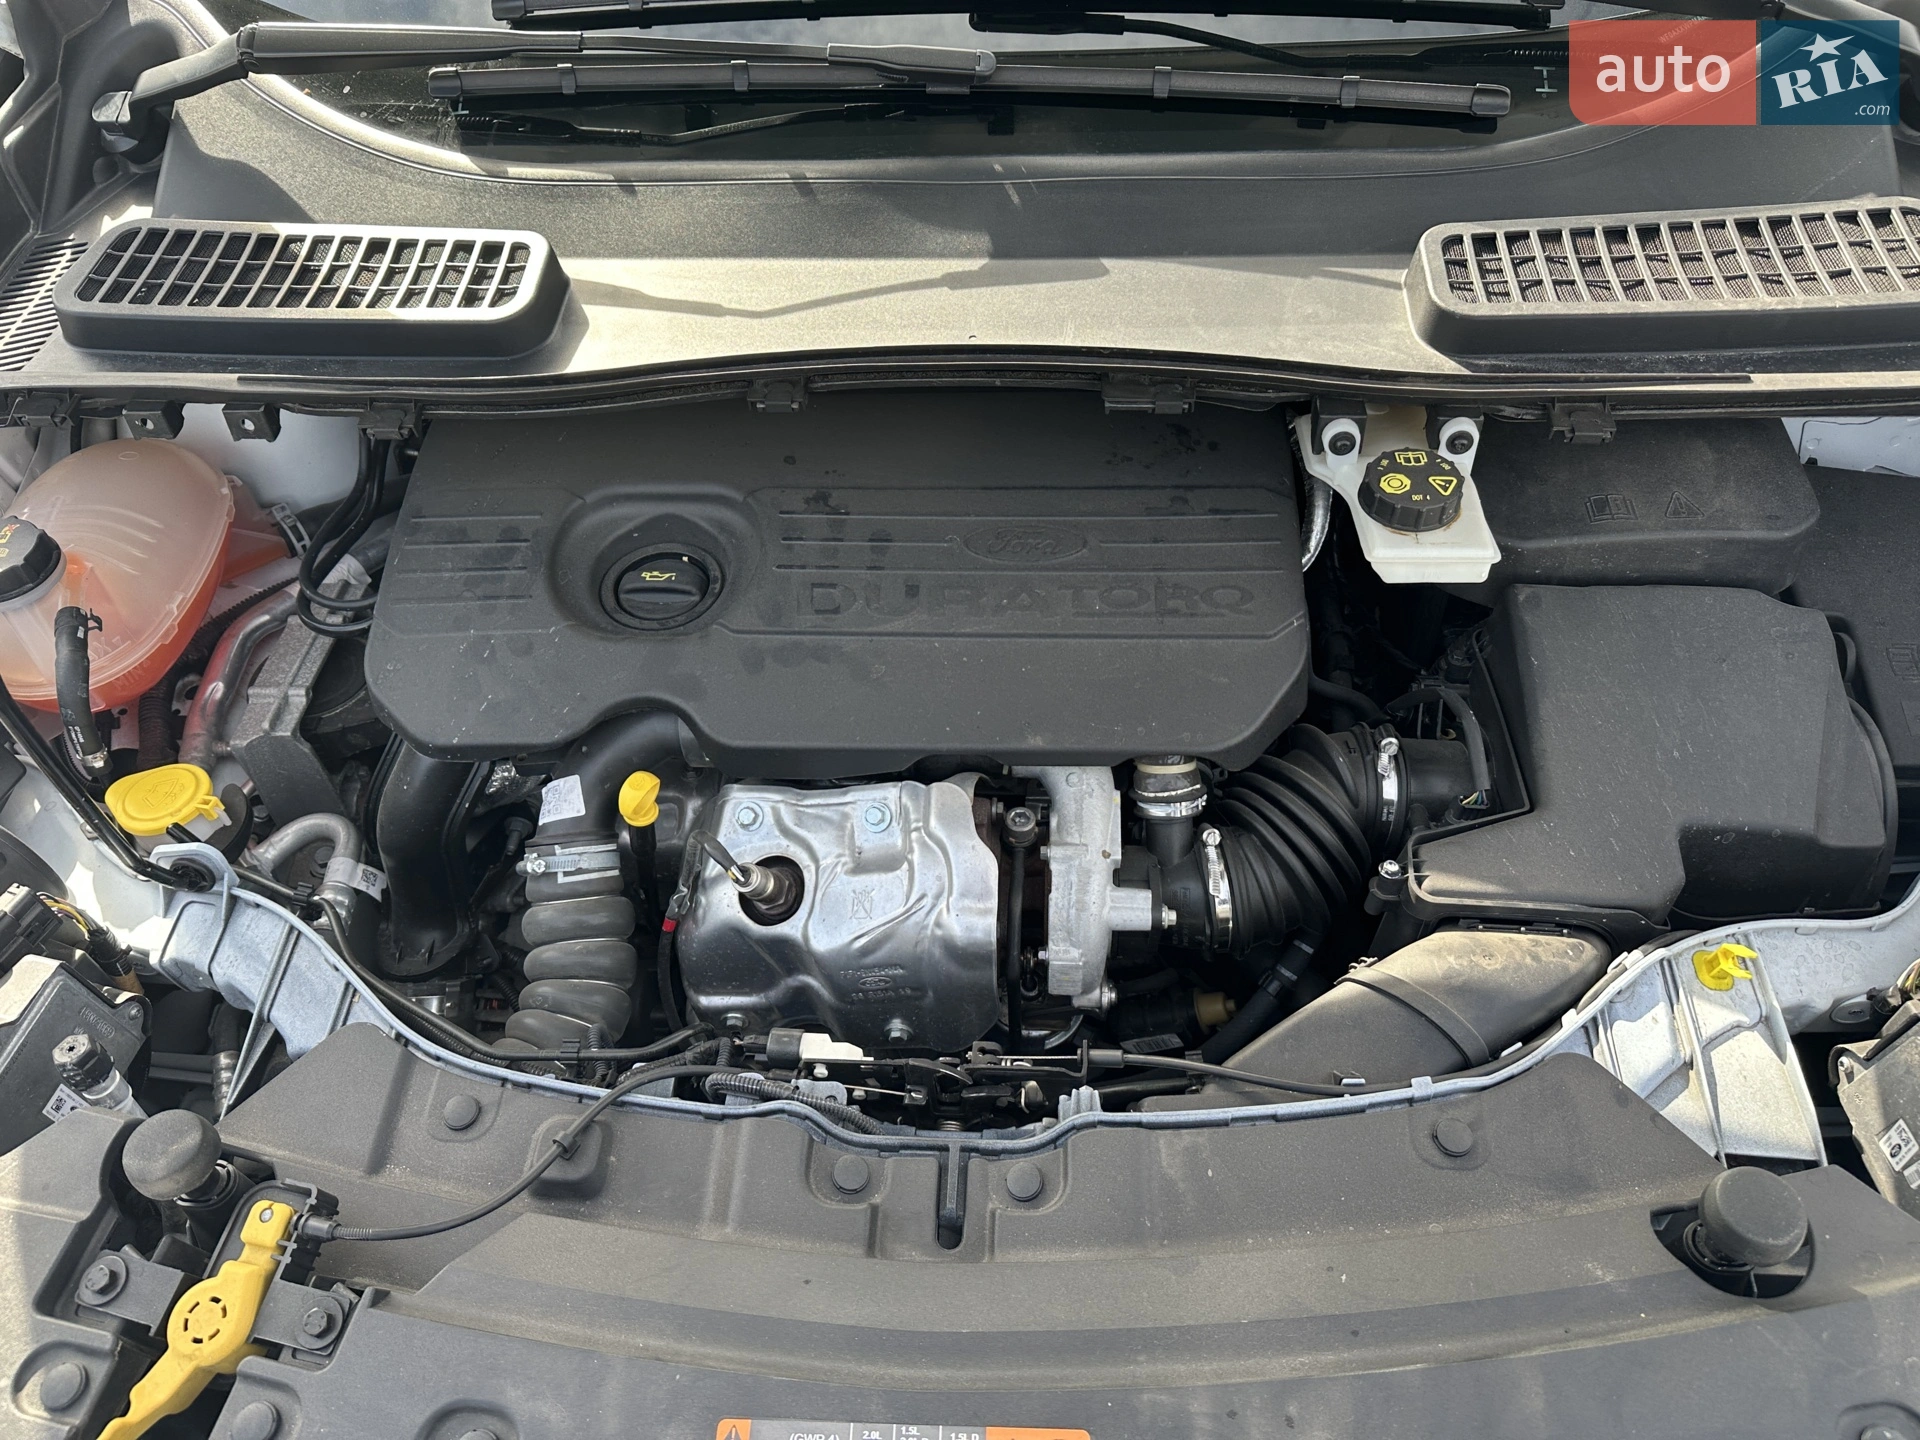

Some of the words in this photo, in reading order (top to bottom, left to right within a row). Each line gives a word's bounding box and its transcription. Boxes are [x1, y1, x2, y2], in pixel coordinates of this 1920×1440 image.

[985, 526, 1064, 556] Ford
[797, 582, 1256, 619] DURATORQ
[862, 1430, 882, 1440] 2.0L
[900, 1426, 920, 1435] 1.5L
